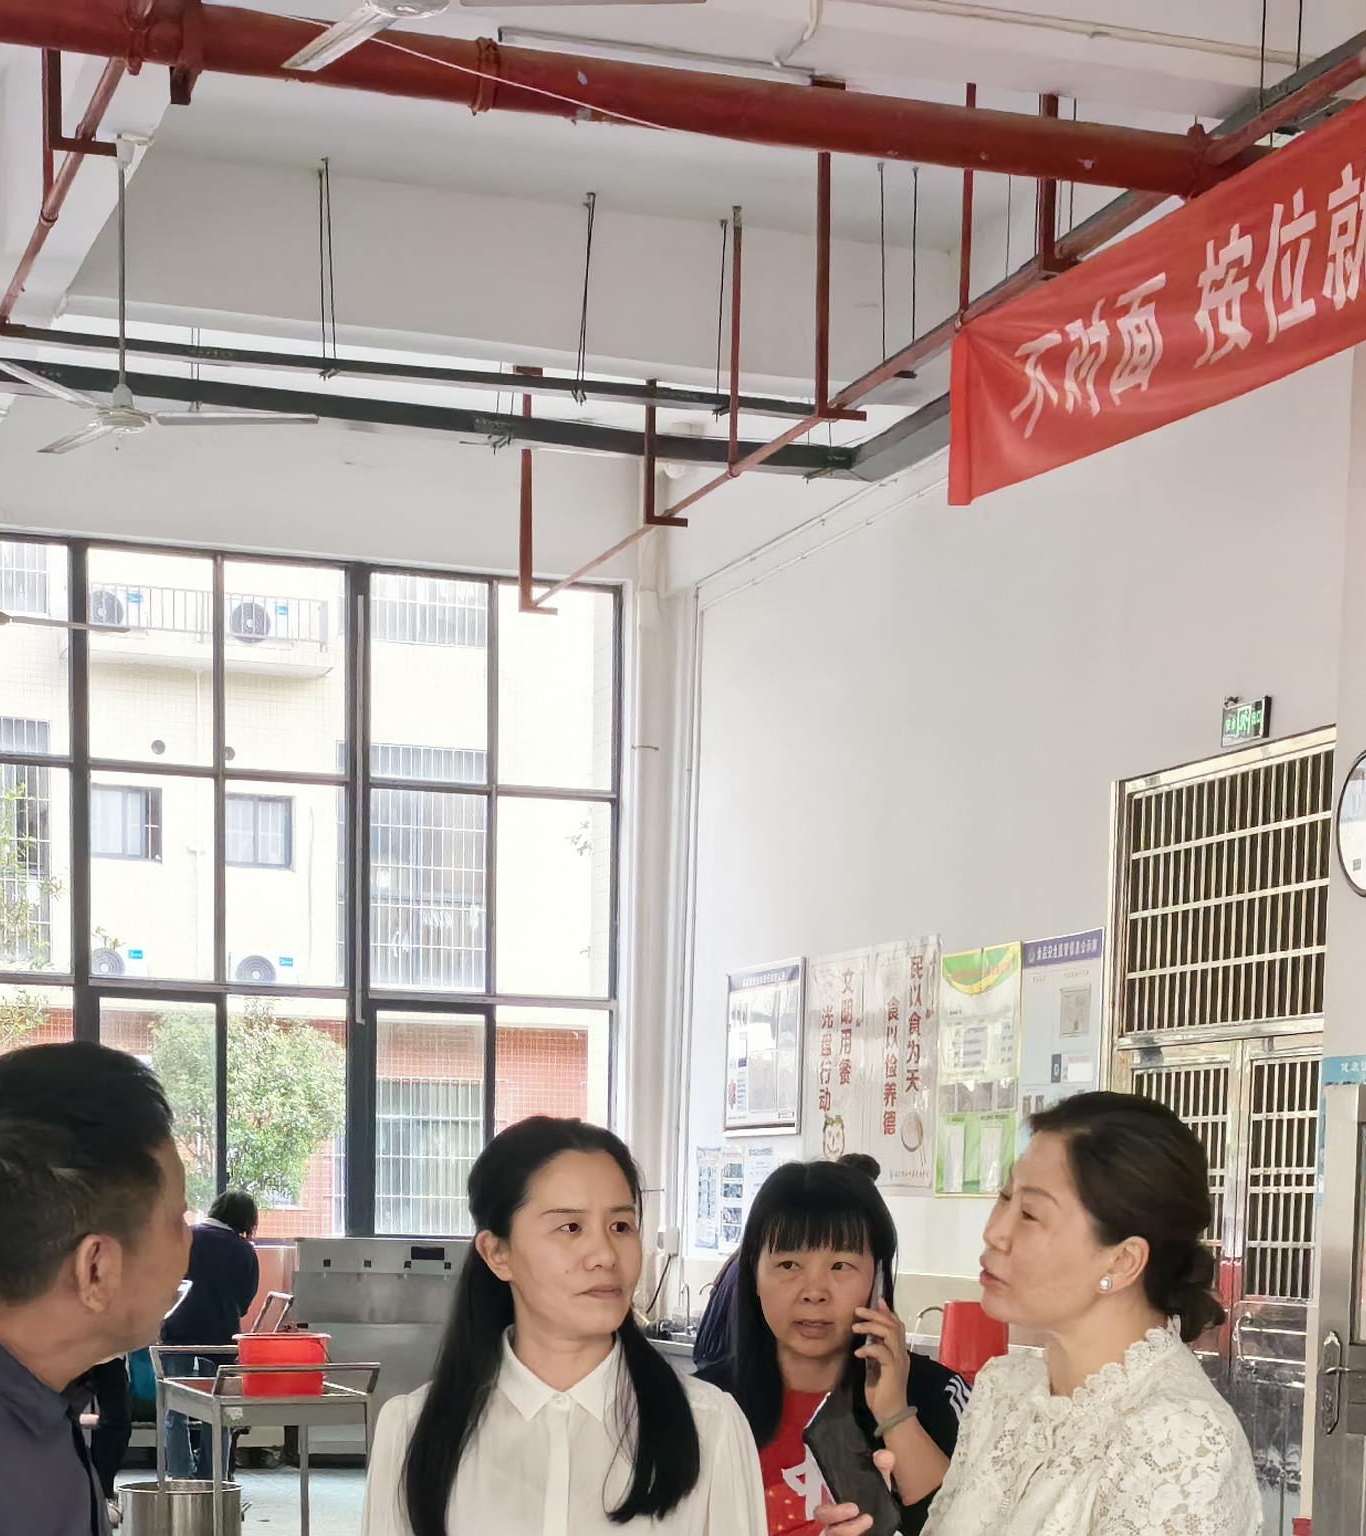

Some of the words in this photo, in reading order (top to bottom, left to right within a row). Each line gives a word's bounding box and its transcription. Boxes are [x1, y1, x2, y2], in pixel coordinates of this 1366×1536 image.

[818, 1004, 835, 1113] 光盘行动
[838, 967, 855, 1086] 文明用餐
[883, 995, 901, 1136] 食以俭养德
[905, 955, 925, 1093] 民以食为天
